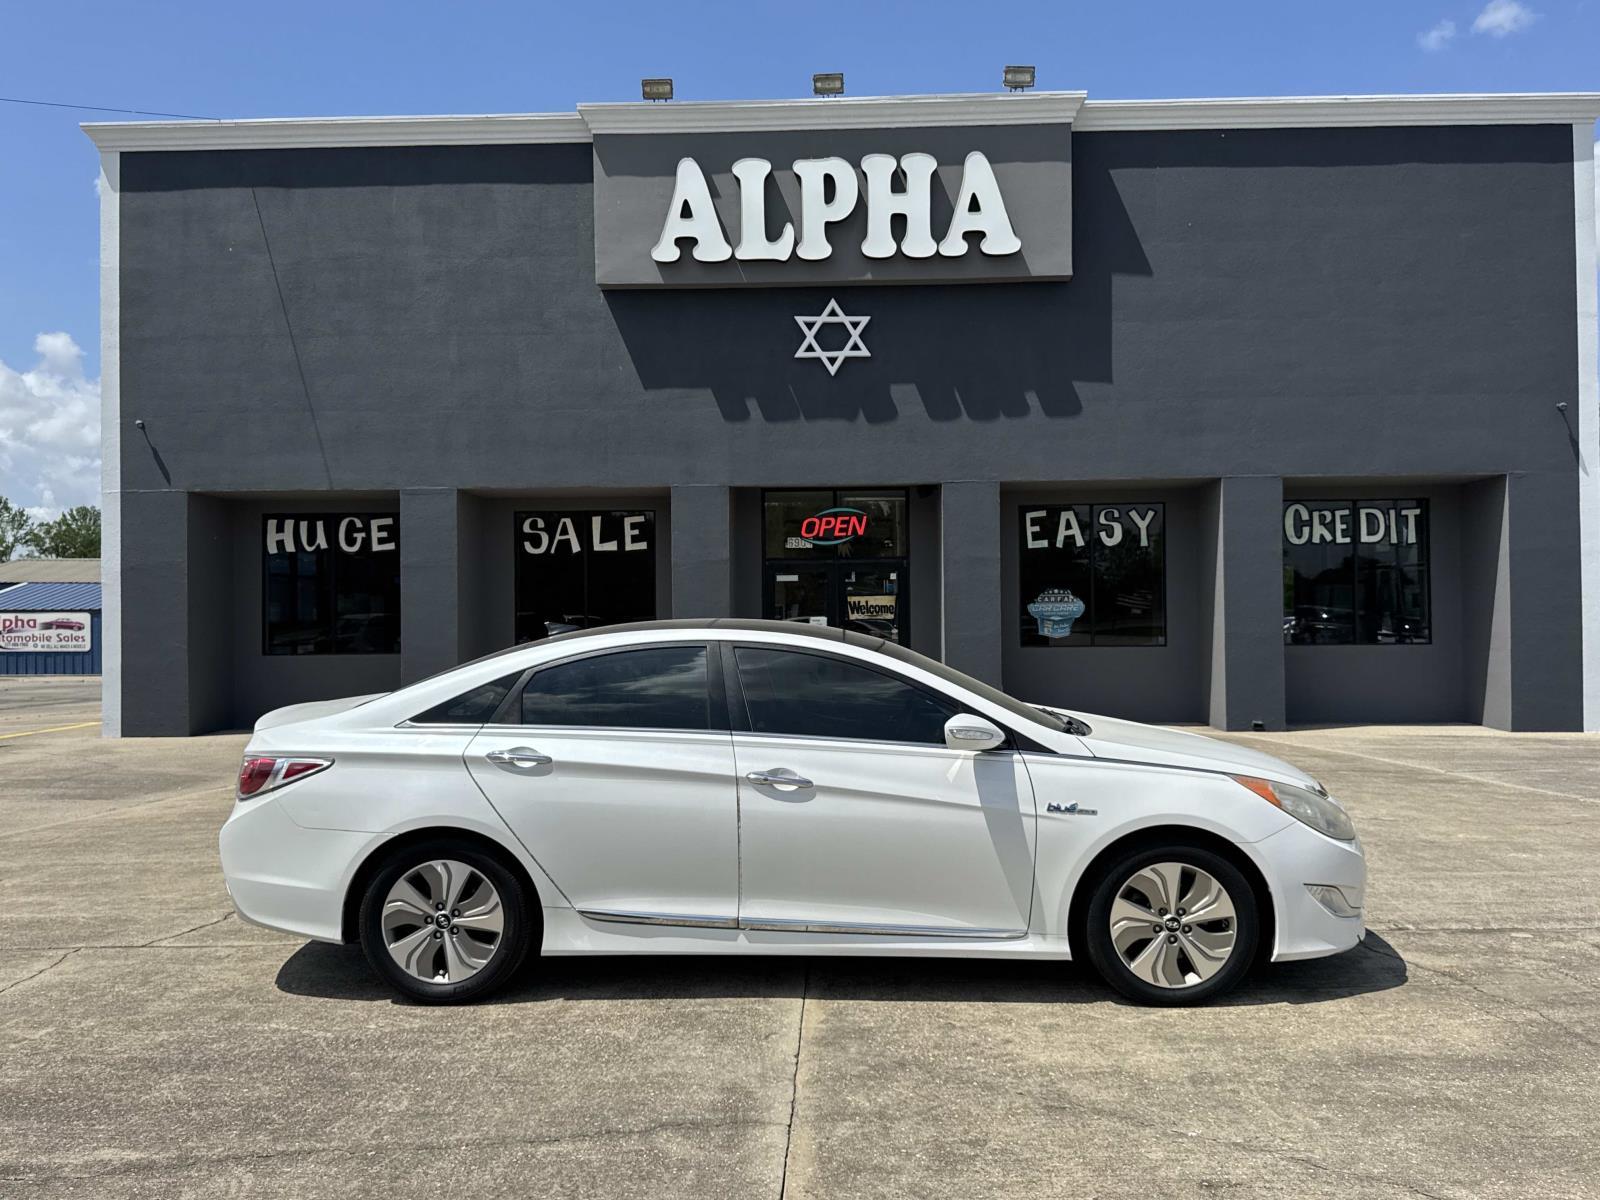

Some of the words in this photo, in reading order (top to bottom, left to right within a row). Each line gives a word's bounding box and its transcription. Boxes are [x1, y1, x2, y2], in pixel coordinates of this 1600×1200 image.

[650, 150, 1022, 262] ALPHA
[266, 516, 396, 555] HUGE
[522, 515, 648, 555] SALE
[801, 515, 867, 538] OPEN
[1025, 507, 1156, 549] EASY
[1284, 503, 1421, 545] CREDIT
[848, 600, 895, 615] Welcome
[0, 615, 37, 632] pha
[0, 633, 52, 643] tomobile
[56, 633, 86, 643] Sales
